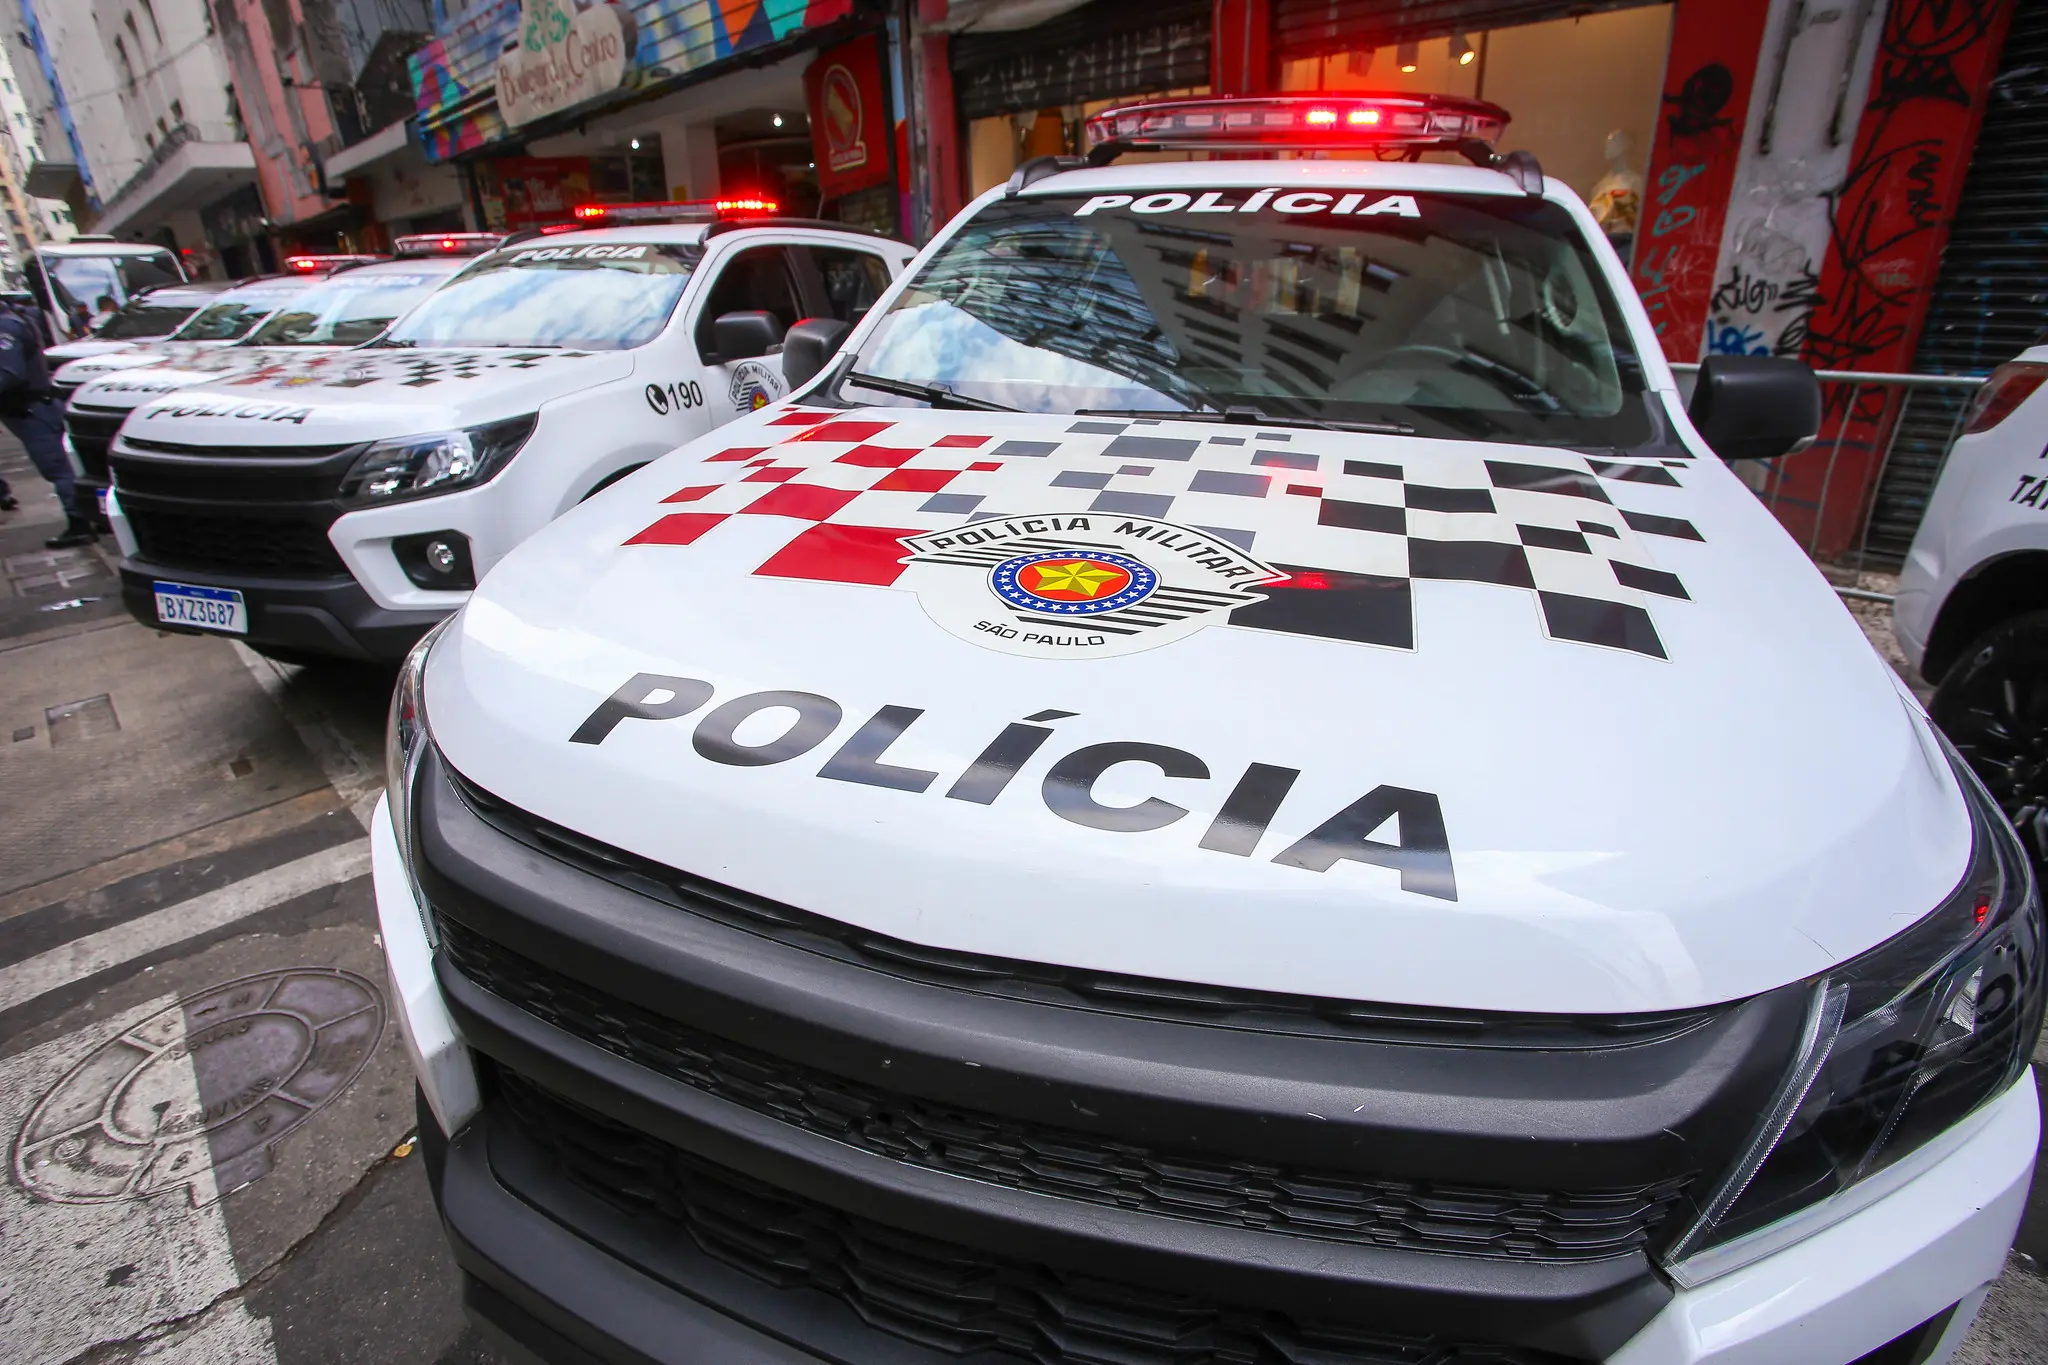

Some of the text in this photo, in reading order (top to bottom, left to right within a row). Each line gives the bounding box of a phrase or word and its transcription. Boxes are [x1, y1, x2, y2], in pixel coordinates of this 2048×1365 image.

[1073, 188, 1421, 218] POLÍCIA
[509, 243, 648, 263] POLÍCIA
[752, 364, 779, 392] MILITAR
[668, 380, 703, 411] 190
[930, 517, 1256, 580] POLÍCIA MILITAR
[165, 596, 235, 627] BXZ3G87
[972, 619, 1105, 647] SÃO PAULO
[568, 671, 1458, 903] POLÍCIA
